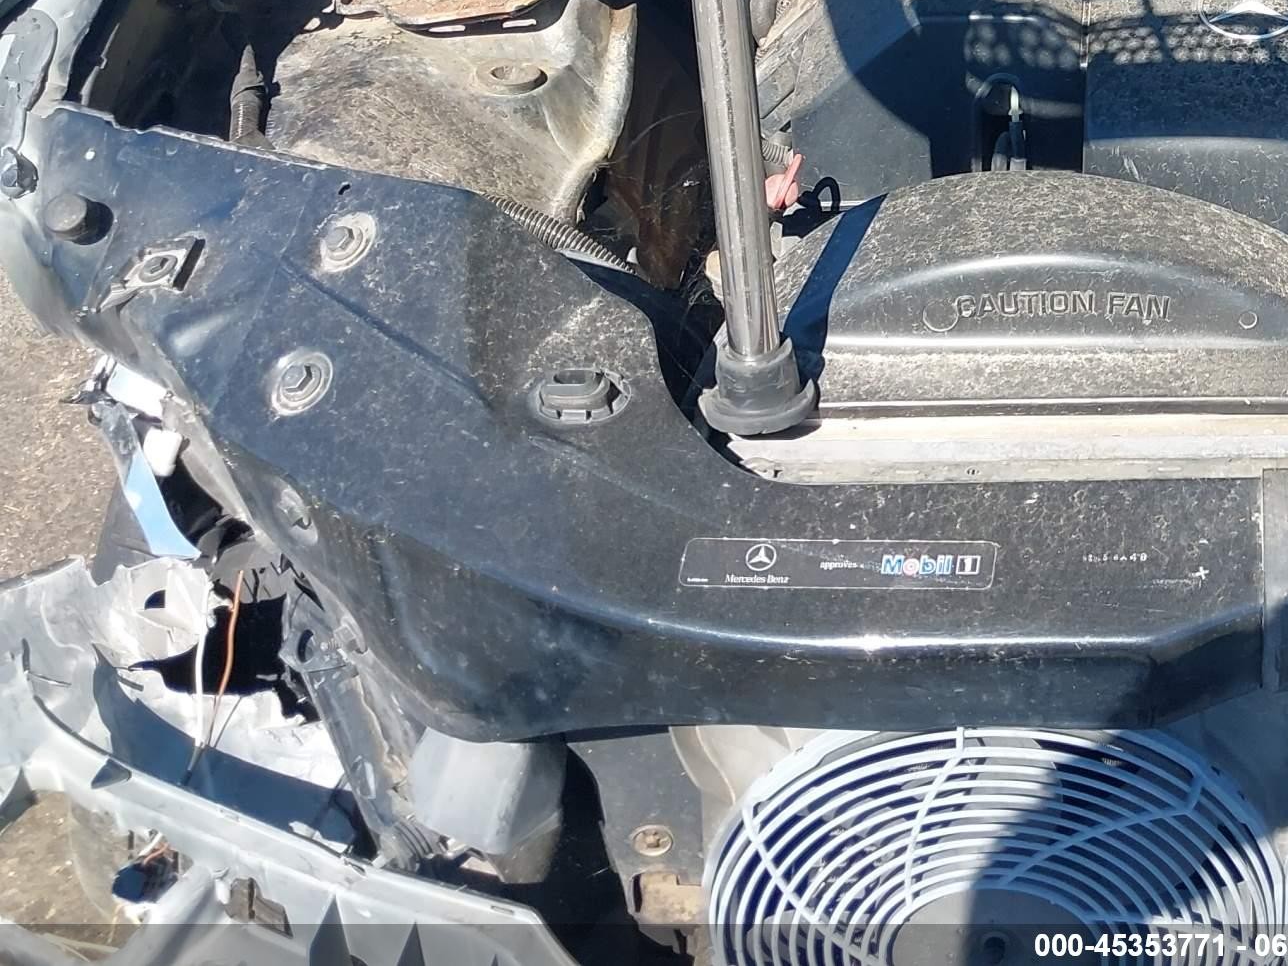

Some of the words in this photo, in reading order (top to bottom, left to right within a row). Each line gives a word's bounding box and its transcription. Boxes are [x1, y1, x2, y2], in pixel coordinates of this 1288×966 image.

[955, 290, 1096, 318] CAUTION
[1106, 291, 1171, 321] FAN
[881, 554, 953, 575] Mobil
